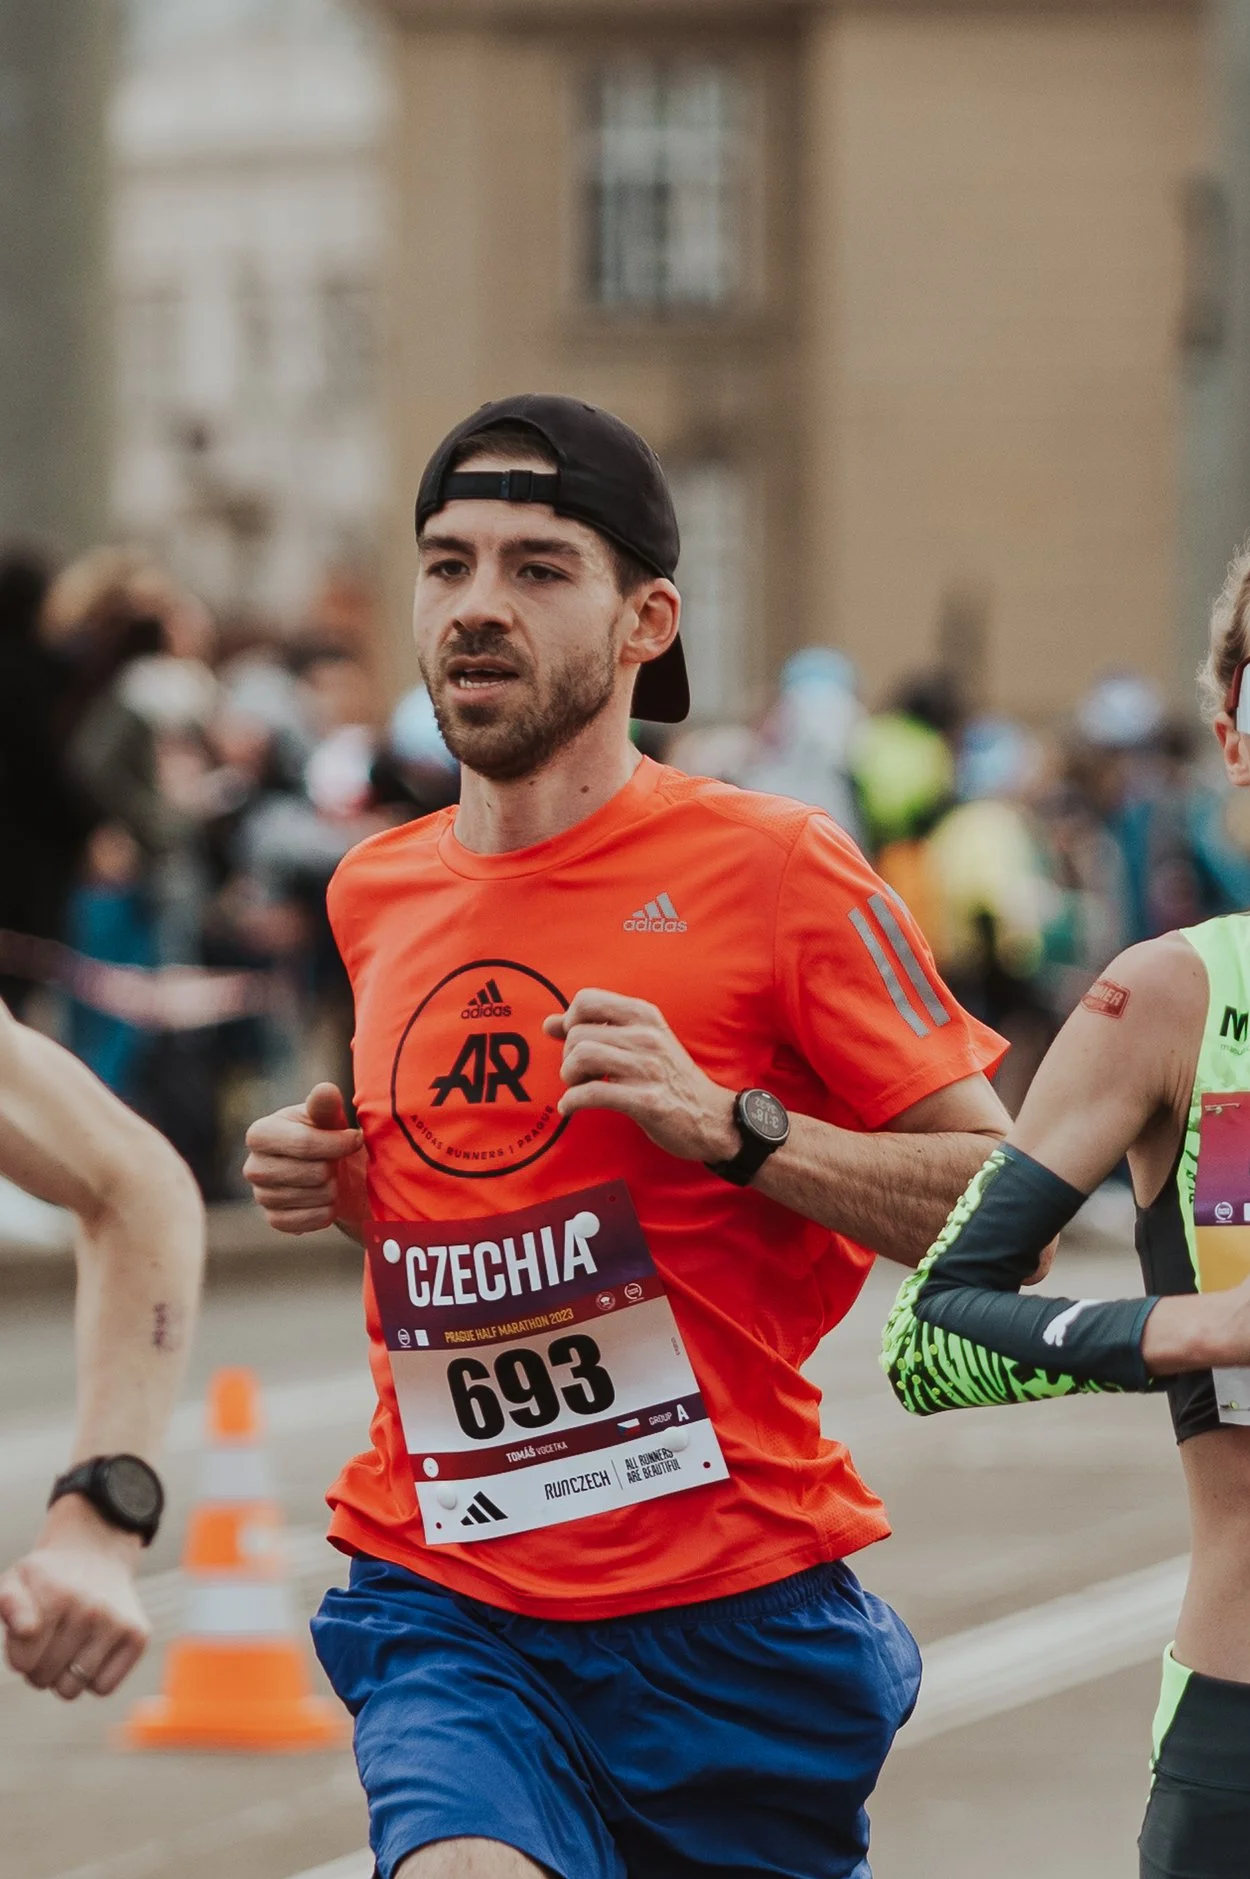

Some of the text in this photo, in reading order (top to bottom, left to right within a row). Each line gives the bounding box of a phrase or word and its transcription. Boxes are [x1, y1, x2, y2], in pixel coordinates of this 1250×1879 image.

[623, 917, 688, 933] adidas
[460, 1003, 512, 1019] adidas
[428, 1032, 532, 1107] AR
[410, 1105, 555, 1160] ADIDAS RUNNERS PRAGUE
[405, 1218, 598, 1308] CZECHIA
[444, 1308, 575, 1344] PRAGUE HALF MARATHON 2023
[446, 1333, 616, 1440] 693
[648, 1403, 690, 1426] GROUP A
[505, 1444, 536, 1464] TOMÁŠ
[624, 1448, 674, 1471] ALL RUNNERS
[544, 1469, 612, 1500] RUNCZECH
[627, 1458, 682, 1484] ARE BEAUTIFUL
